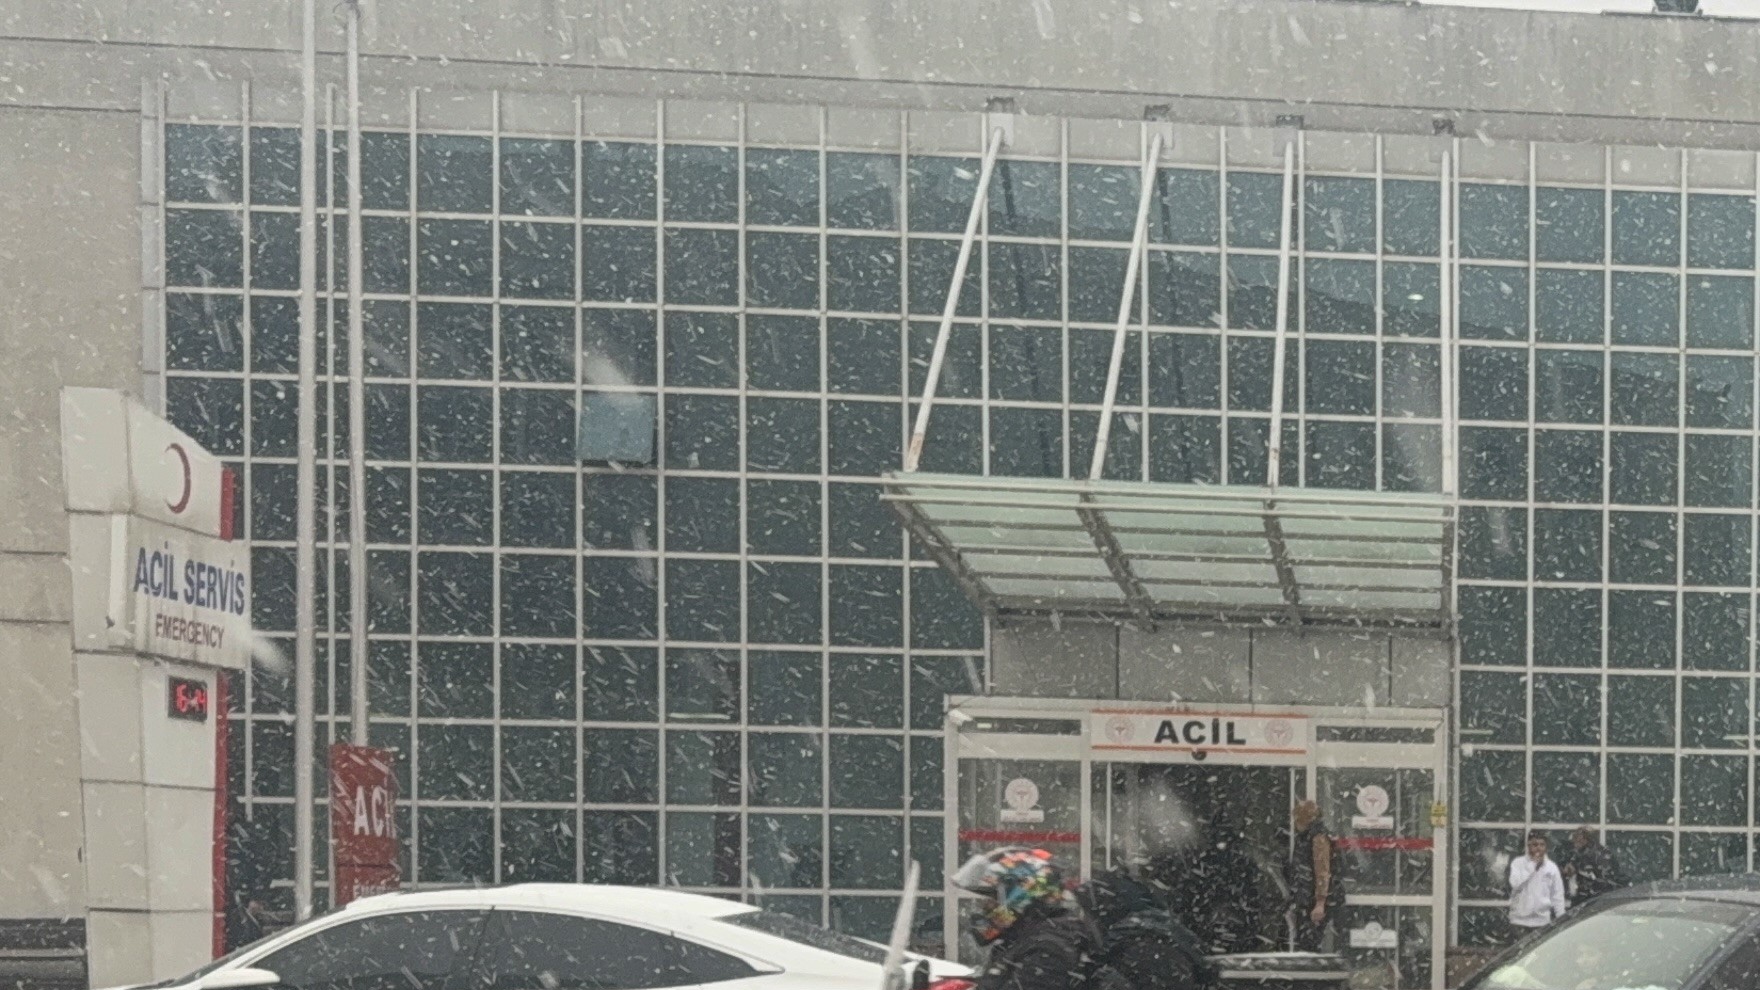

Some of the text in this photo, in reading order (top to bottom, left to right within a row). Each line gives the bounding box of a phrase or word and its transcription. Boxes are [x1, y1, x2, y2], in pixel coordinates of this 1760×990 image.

[184, 558, 245, 616] SERVİS
[155, 612, 225, 649] EMERGENCY
[1153, 717, 1247, 746] ACİL
